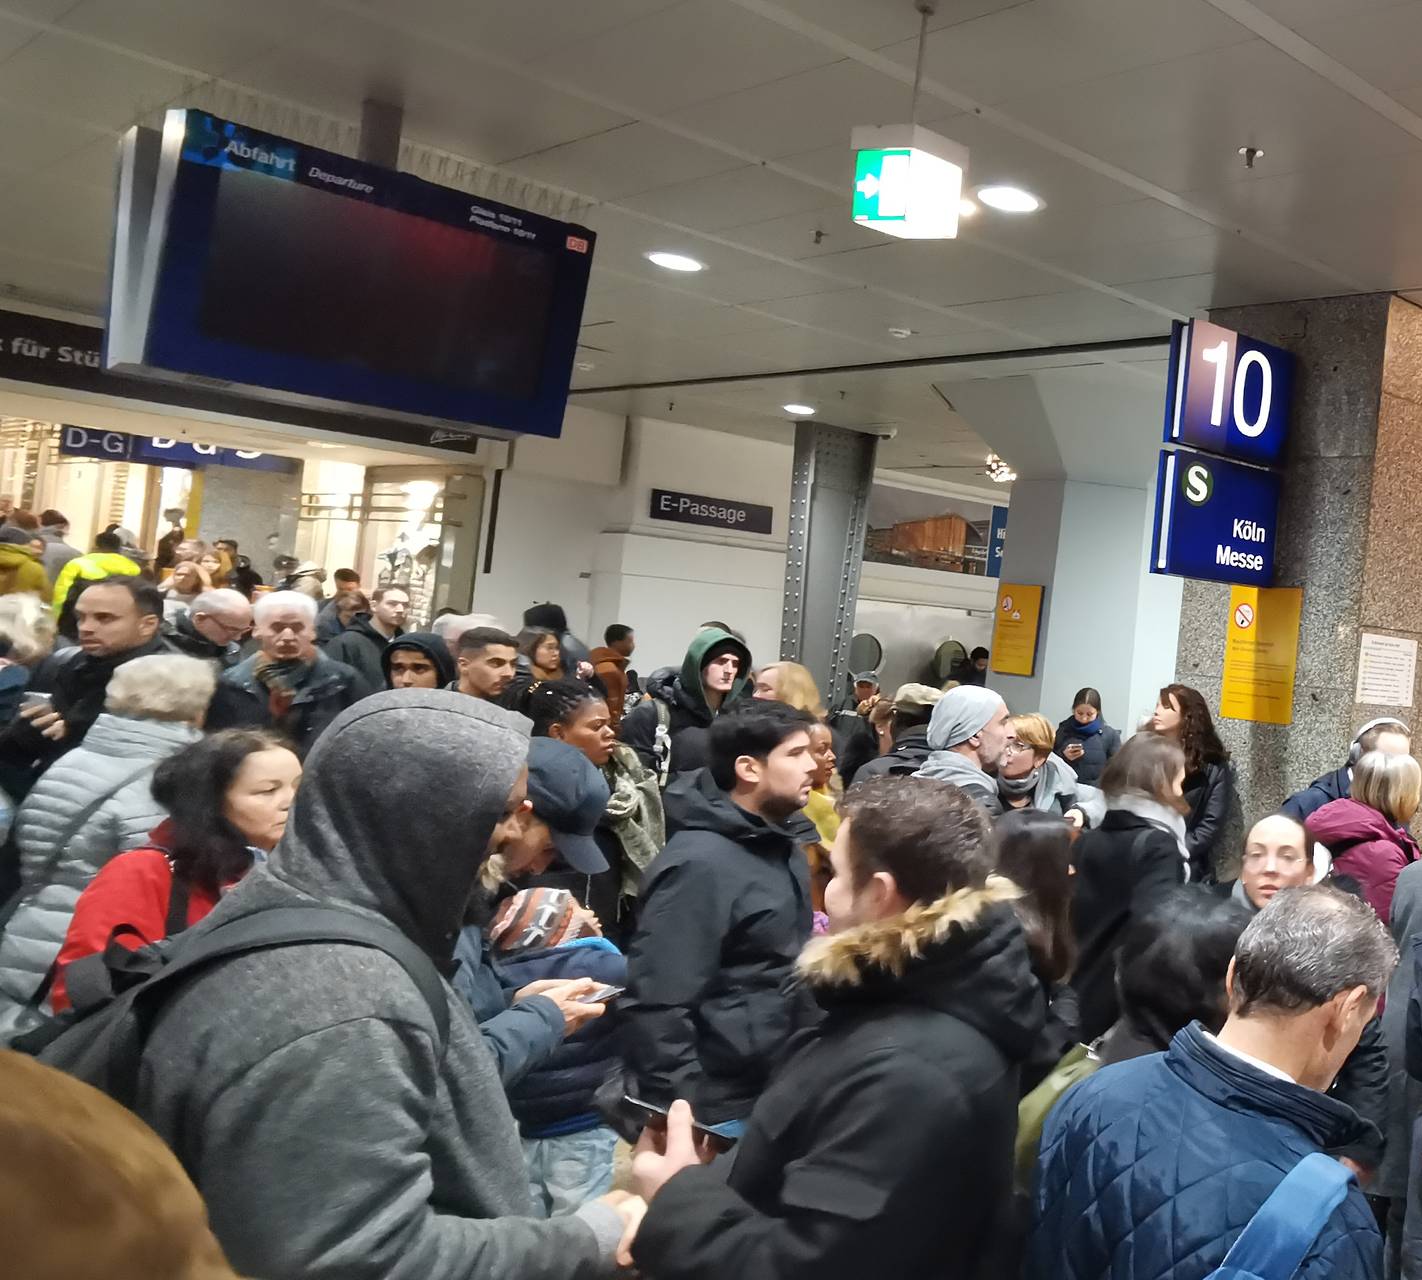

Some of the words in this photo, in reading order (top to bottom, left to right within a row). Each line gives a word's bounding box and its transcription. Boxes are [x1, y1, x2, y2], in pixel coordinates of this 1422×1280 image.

[224, 140, 296, 172] Abfahrt
[308, 166, 374, 195] Departure
[567, 237, 587, 253] DB
[11, 337, 50, 359] für
[1202, 340, 1273, 438] 10
[1186, 465, 1209, 503] S
[660, 495, 747, 524] E-Passage
[1232, 518, 1266, 542] Köln
[1215, 544, 1264, 571] Messe
